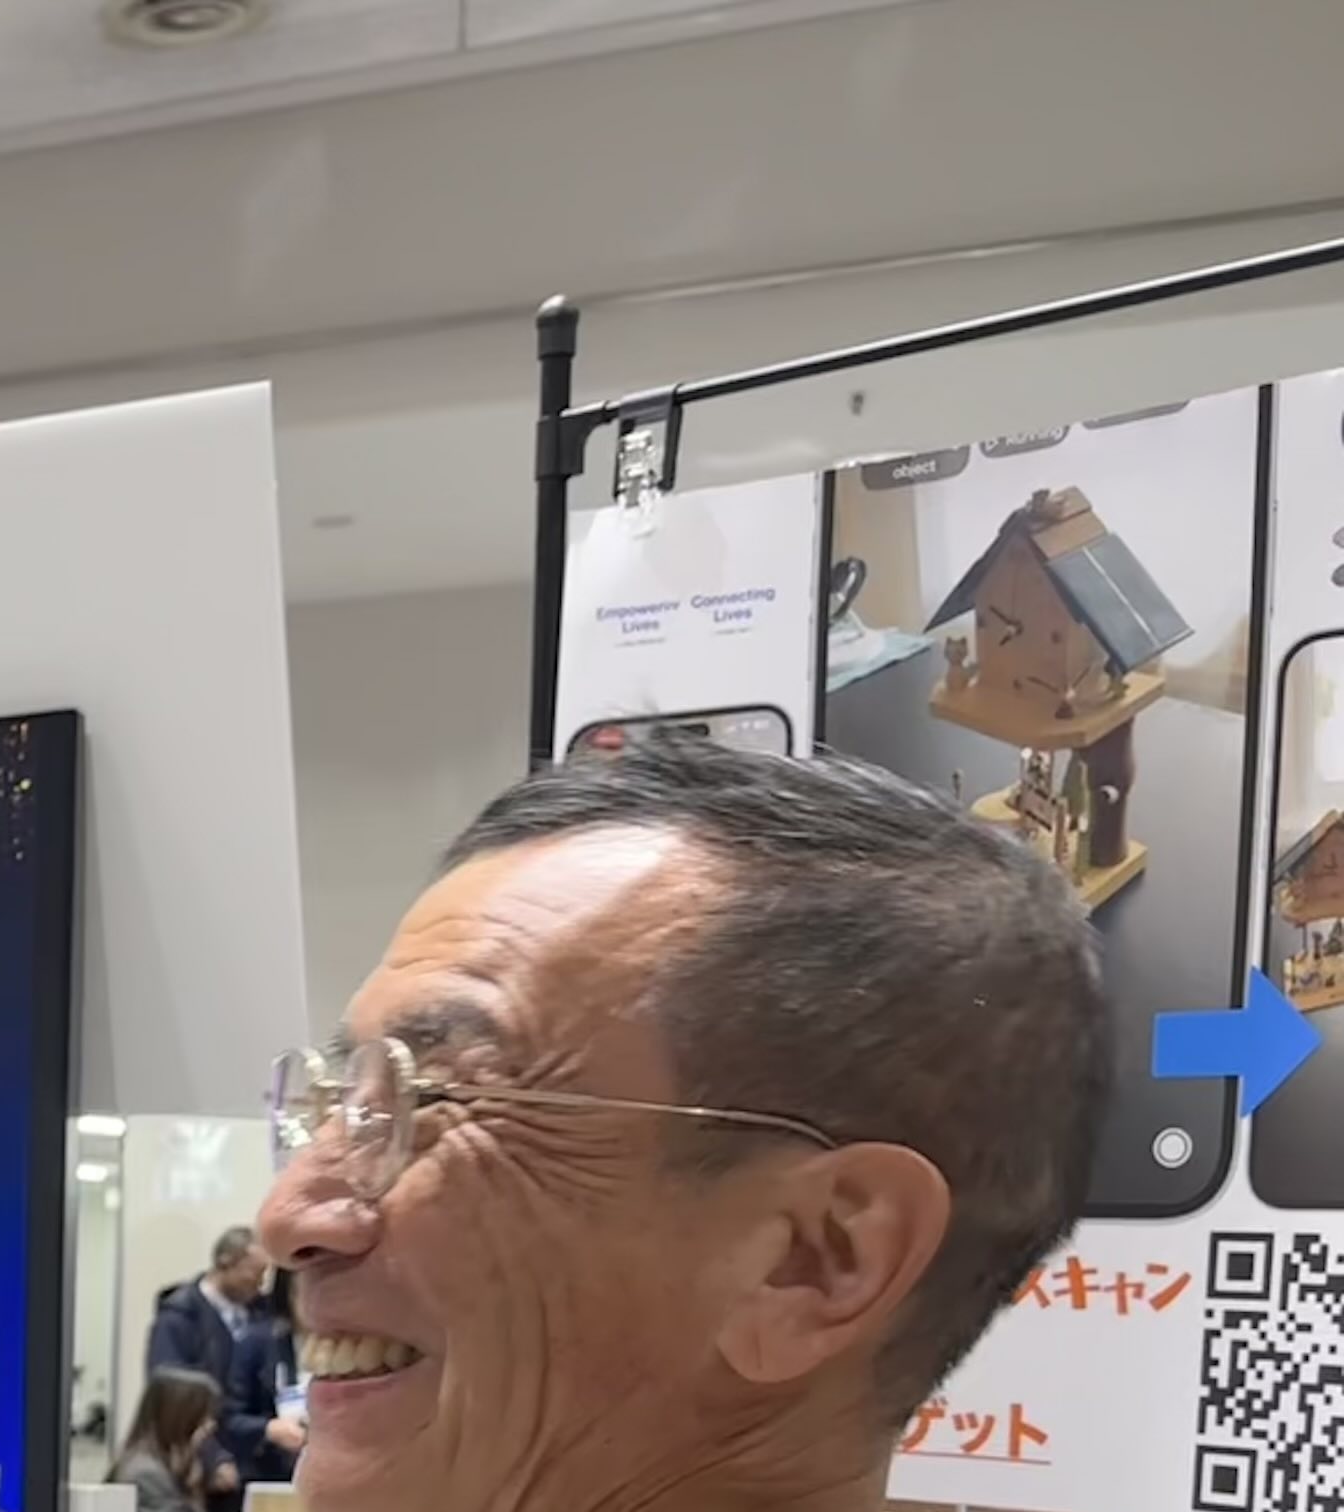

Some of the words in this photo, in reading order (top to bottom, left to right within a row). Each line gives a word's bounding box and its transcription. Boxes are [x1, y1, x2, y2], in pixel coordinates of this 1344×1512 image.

[892, 460, 936, 479] object
[690, 587, 776, 609] Connecting
[713, 608, 752, 623] Lives
[622, 619, 660, 634] Lives
